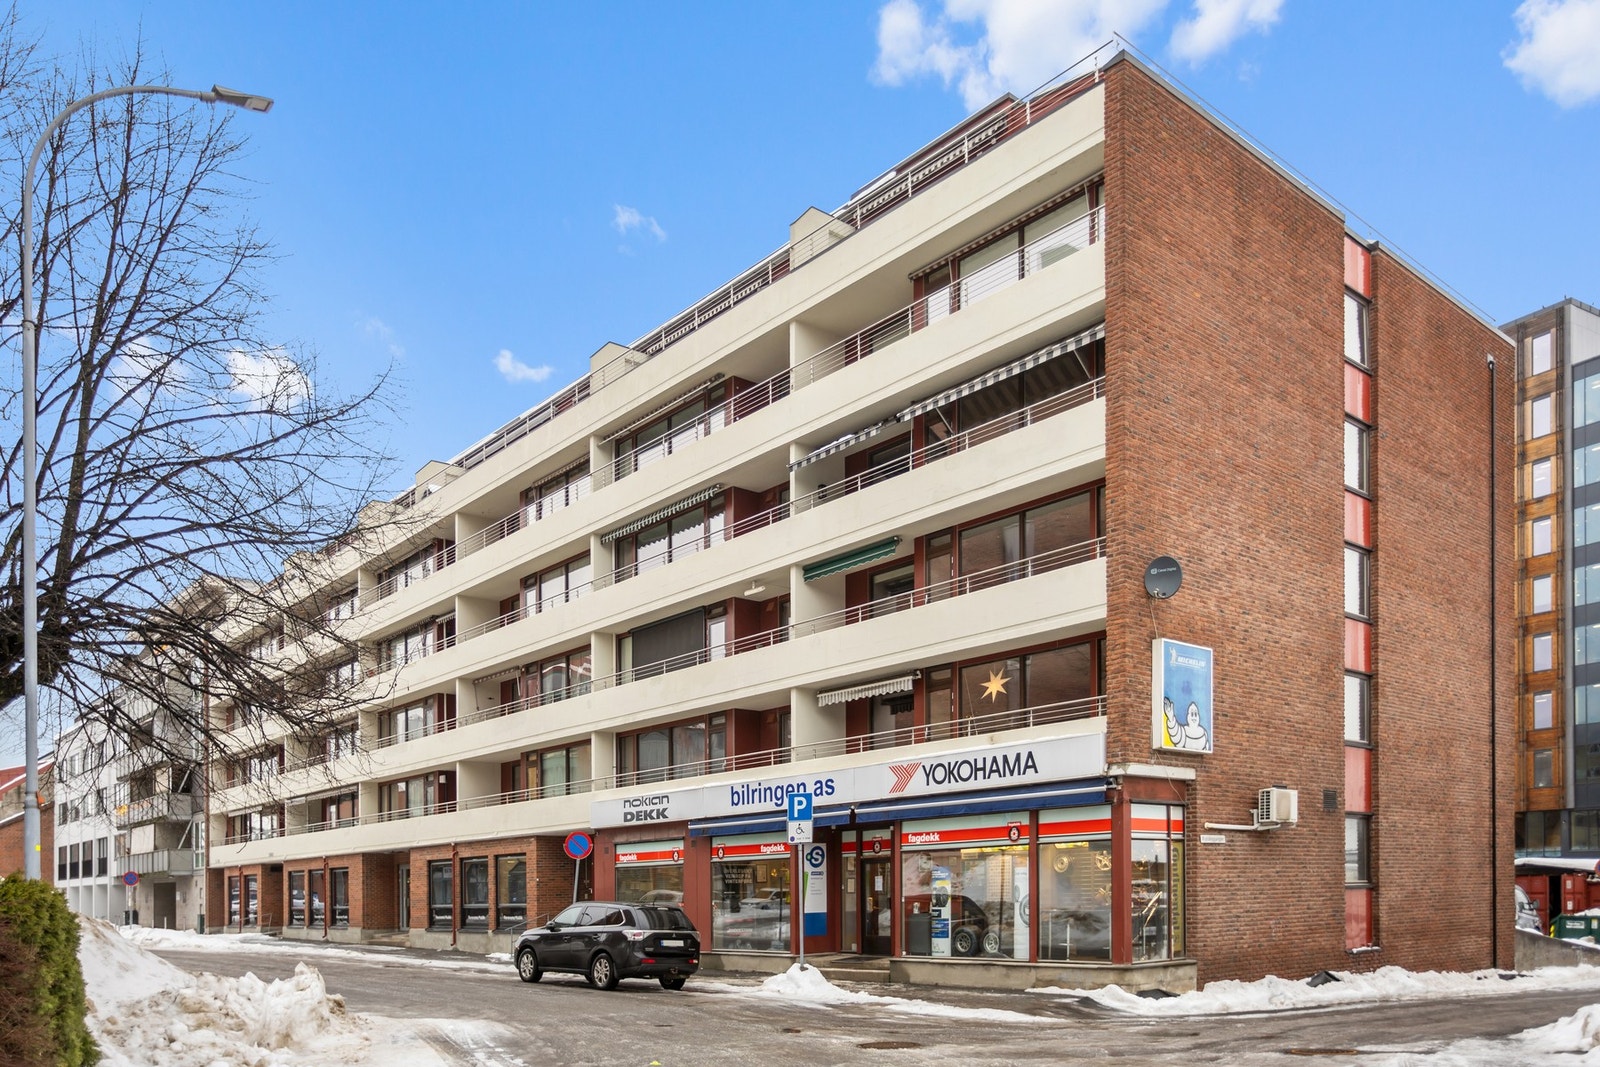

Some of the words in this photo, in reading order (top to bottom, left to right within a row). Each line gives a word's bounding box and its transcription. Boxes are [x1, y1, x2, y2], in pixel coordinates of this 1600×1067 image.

[1177, 656, 1206, 668] MICHELIN
[922, 751, 1039, 786] YOKOHAMA
[730, 781, 807, 807] bilringen
[813, 778, 835, 797] as
[623, 795, 670, 809] nokian
[793, 796, 807, 818] P
[623, 807, 669, 823] DEKK
[908, 832, 940, 844] fagdekk
[760, 843, 785, 854] fagdekk
